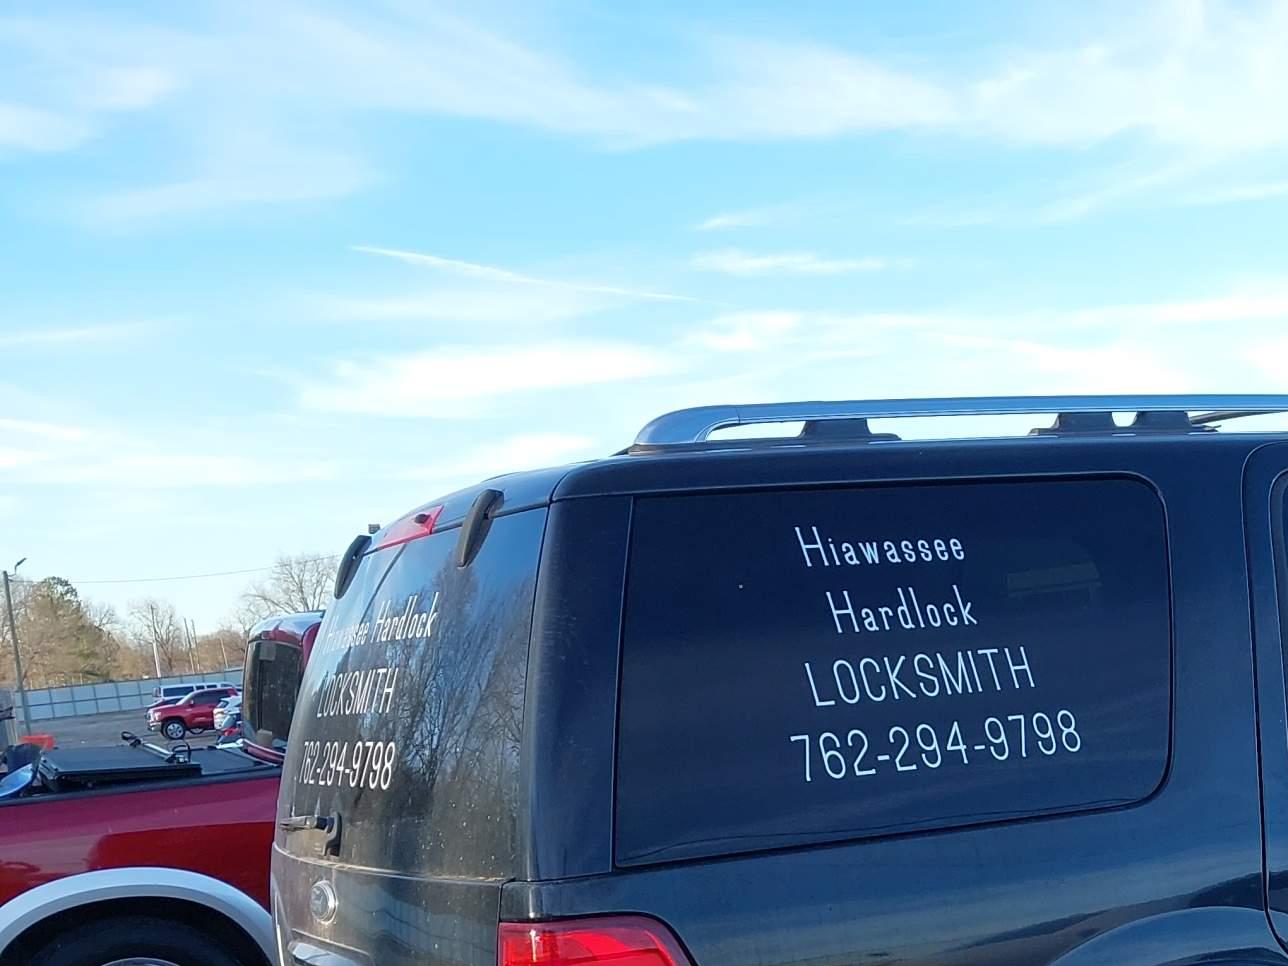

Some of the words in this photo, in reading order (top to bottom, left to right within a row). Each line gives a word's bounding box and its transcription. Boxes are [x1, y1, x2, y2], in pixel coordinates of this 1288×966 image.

[794, 526, 965, 567] Hiawassee
[370, 591, 440, 643] Hardlock
[825, 585, 978, 634] Hardlock
[316, 667, 399, 718] LOCKSMITH
[804, 646, 1035, 707] LOCKSMITH
[298, 740, 396, 790] 762-294-9798
[789, 709, 1081, 782] 762-294-9798
